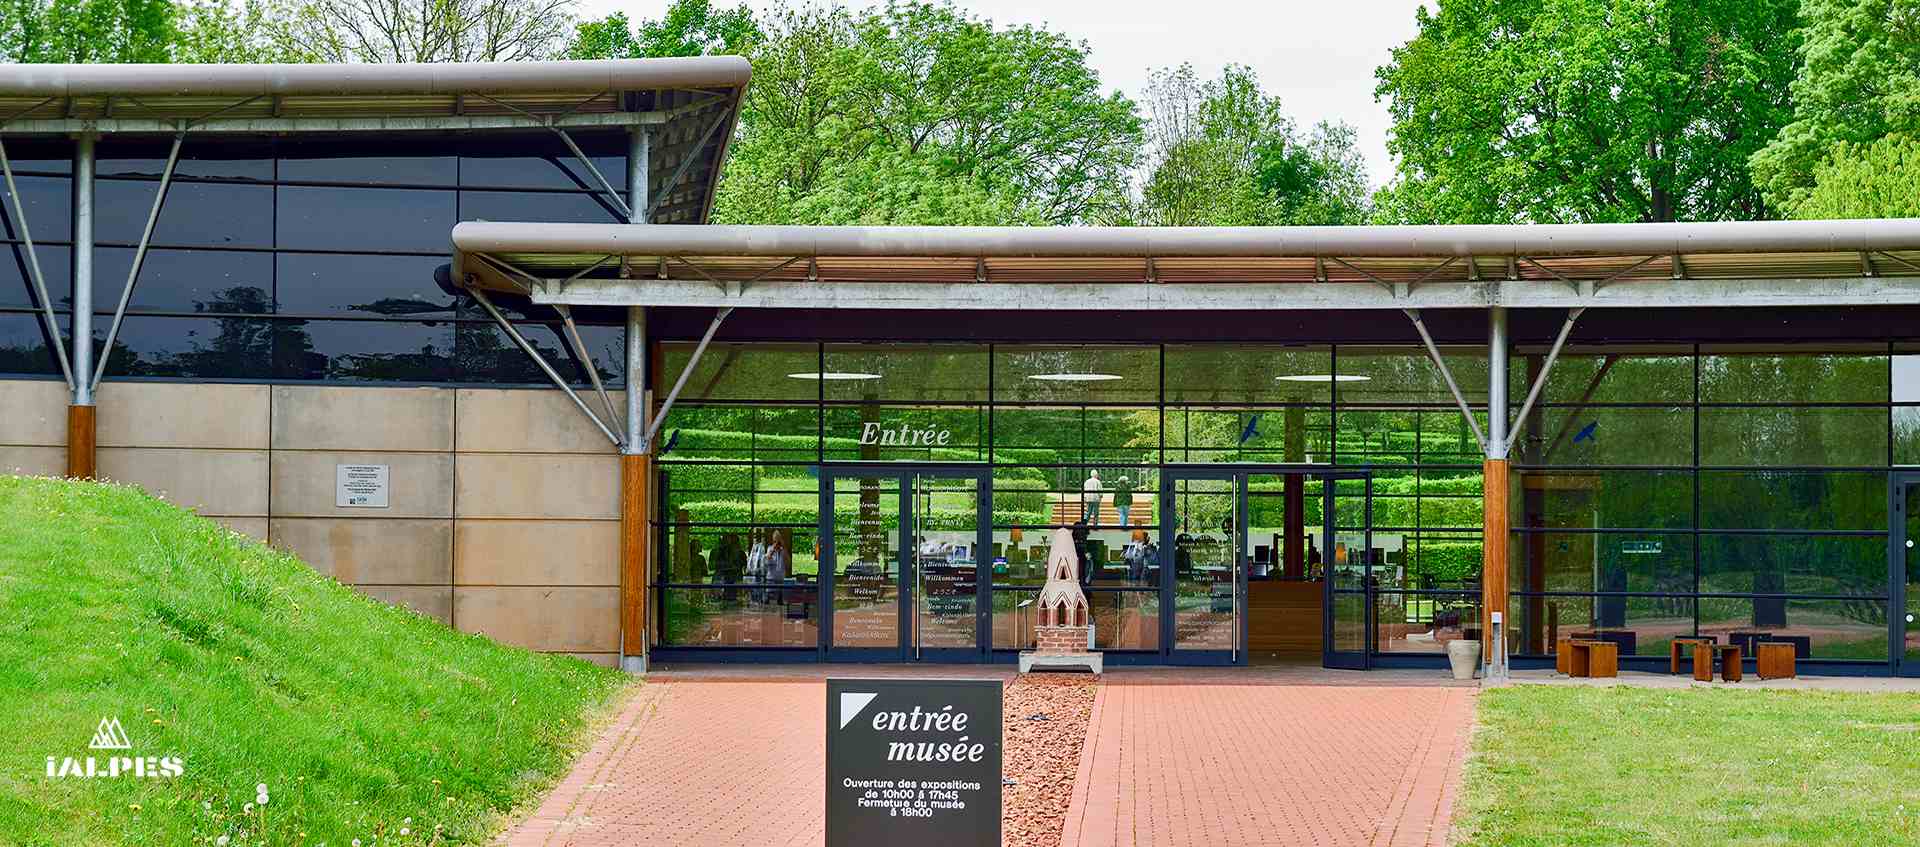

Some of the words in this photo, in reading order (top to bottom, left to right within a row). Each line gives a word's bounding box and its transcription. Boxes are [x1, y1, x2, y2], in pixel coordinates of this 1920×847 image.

[859, 422, 950, 446] Entrée
[872, 705, 969, 732] entrée
[887, 736, 985, 763] musée
[843, 777, 894, 788] Ouverture
[898, 779, 917, 789] des
[920, 780, 981, 791] expositions
[865, 789, 878, 799] de
[882, 788, 914, 800] 10h00
[929, 790, 959, 800] 17h45
[858, 798, 910, 808] Fermeture
[913, 799, 927, 809] du
[930, 799, 965, 809] musée
[901, 807, 933, 818] 18h00
